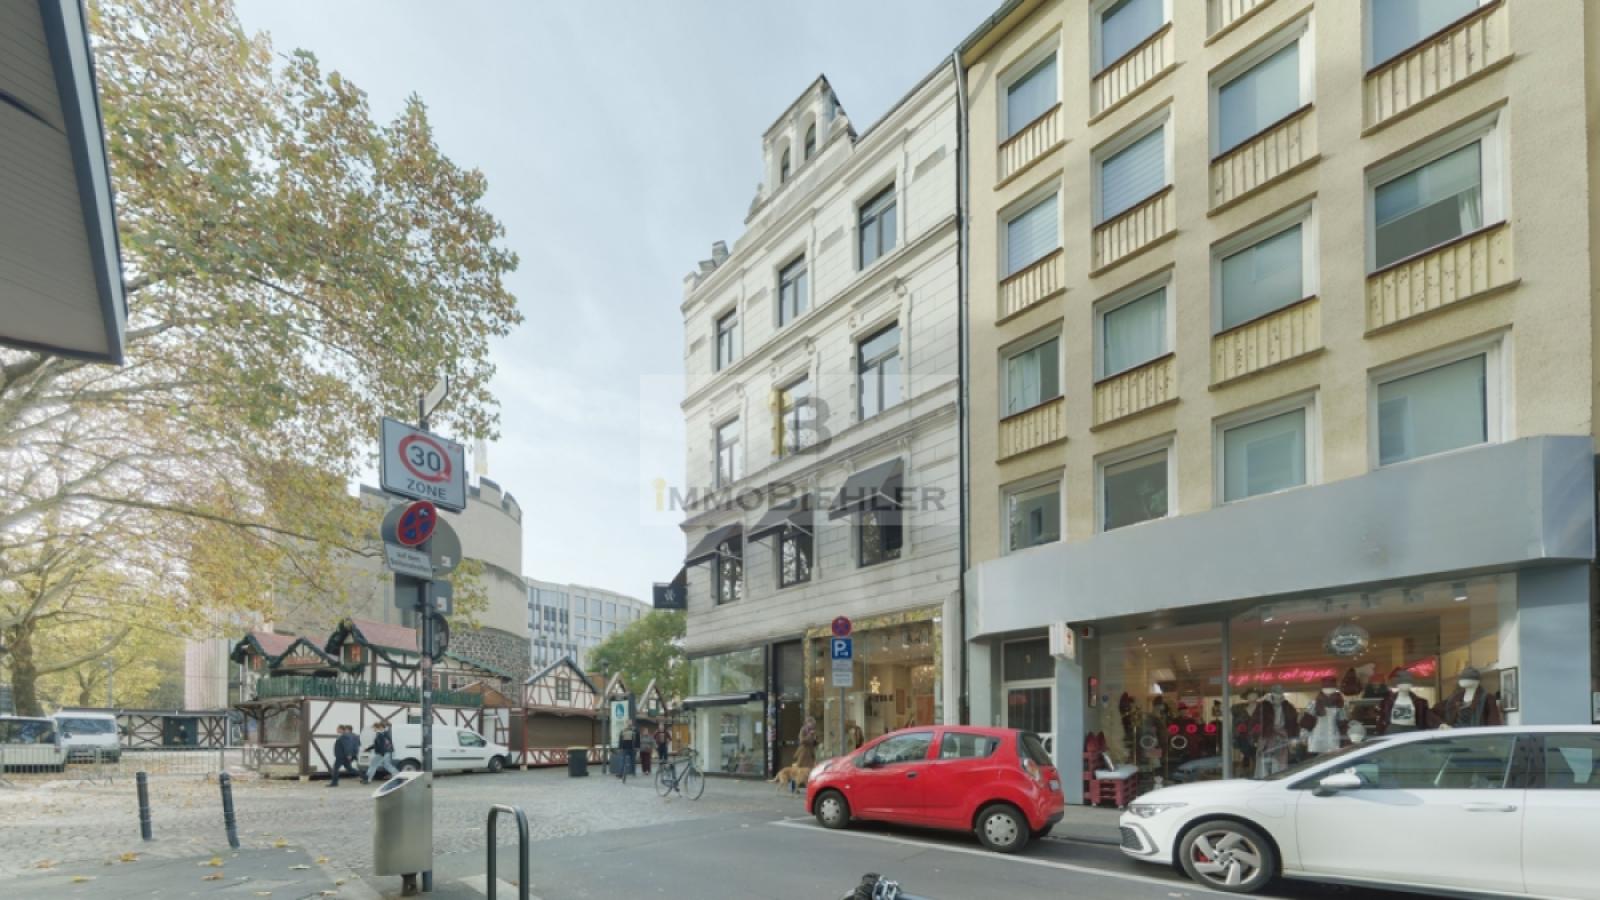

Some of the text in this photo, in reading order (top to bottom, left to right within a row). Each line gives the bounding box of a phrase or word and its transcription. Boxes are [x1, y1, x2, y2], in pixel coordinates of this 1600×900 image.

[411, 445, 441, 472] 30
[407, 478, 448, 499] ZONE
[834, 640, 847, 657] P
